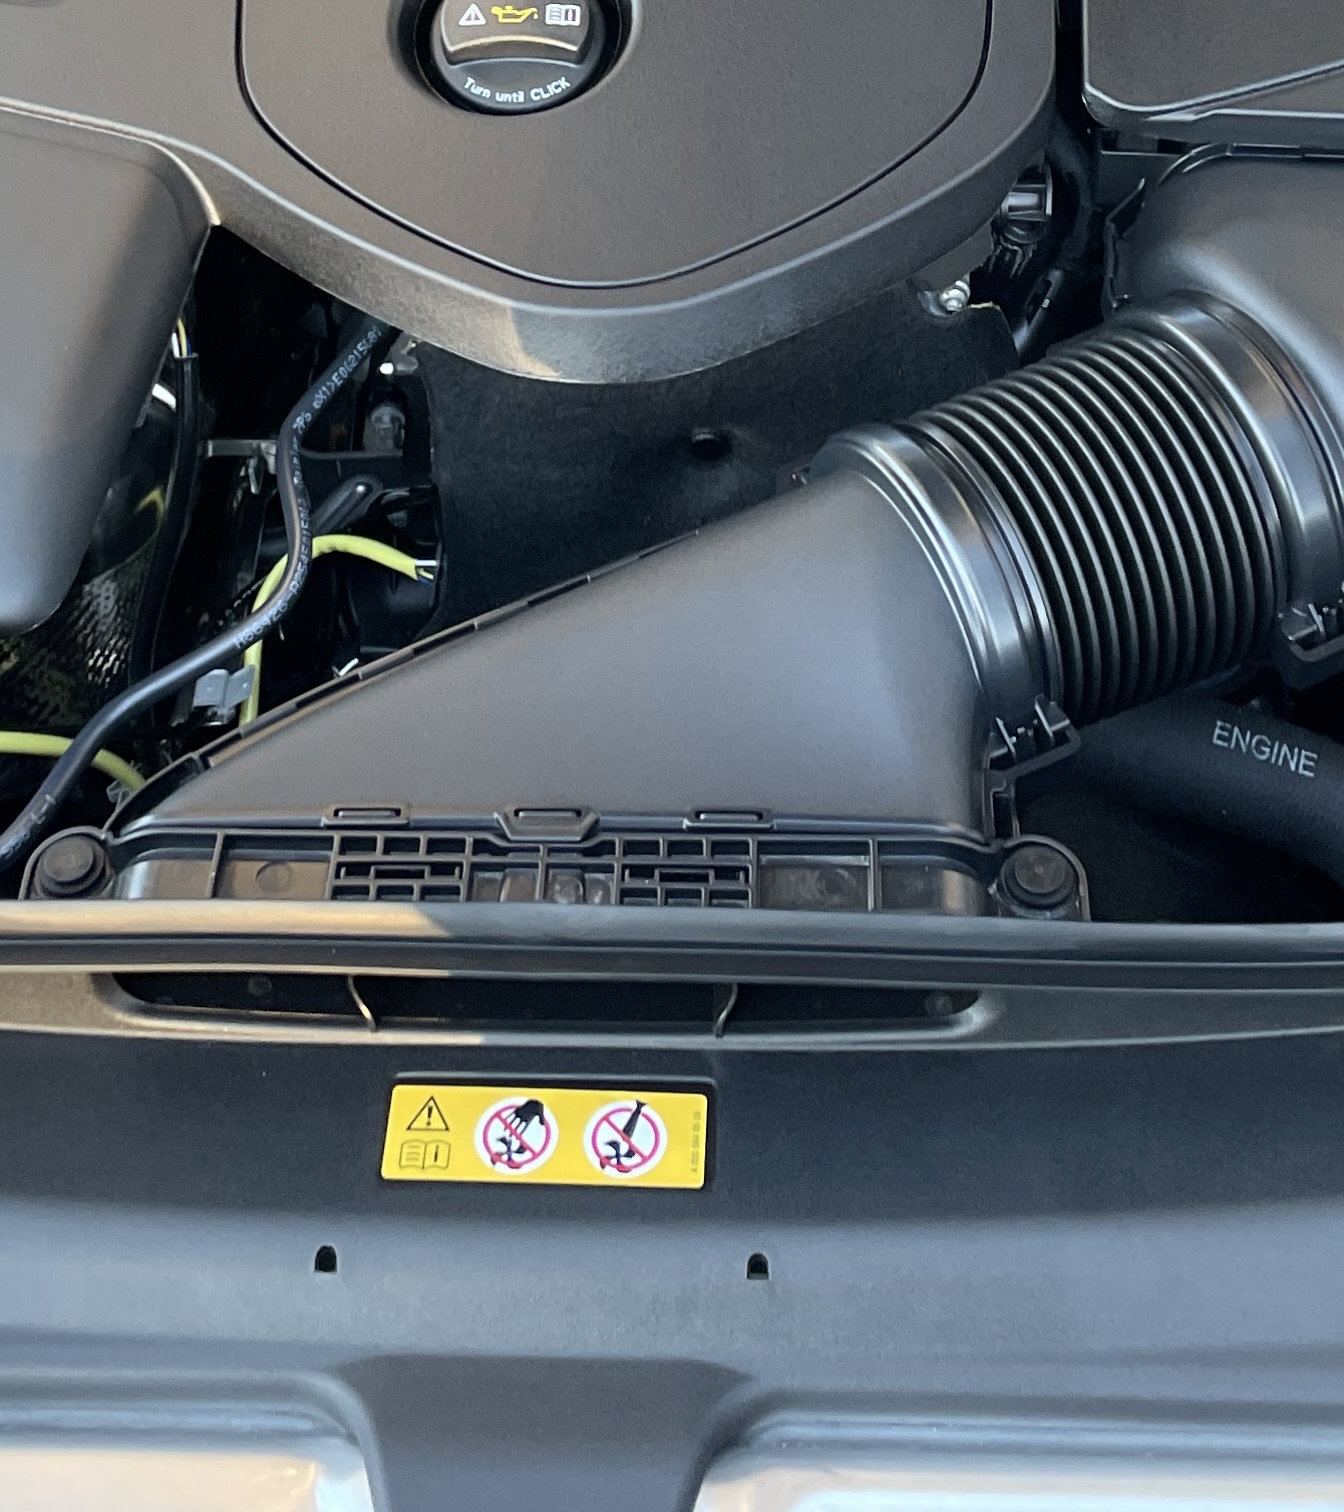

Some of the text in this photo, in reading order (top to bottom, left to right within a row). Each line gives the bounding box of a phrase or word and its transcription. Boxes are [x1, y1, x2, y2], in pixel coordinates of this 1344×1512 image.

[463, 76, 571, 104] Turn until CLICK
[1211, 719, 1319, 778] ENGINE
